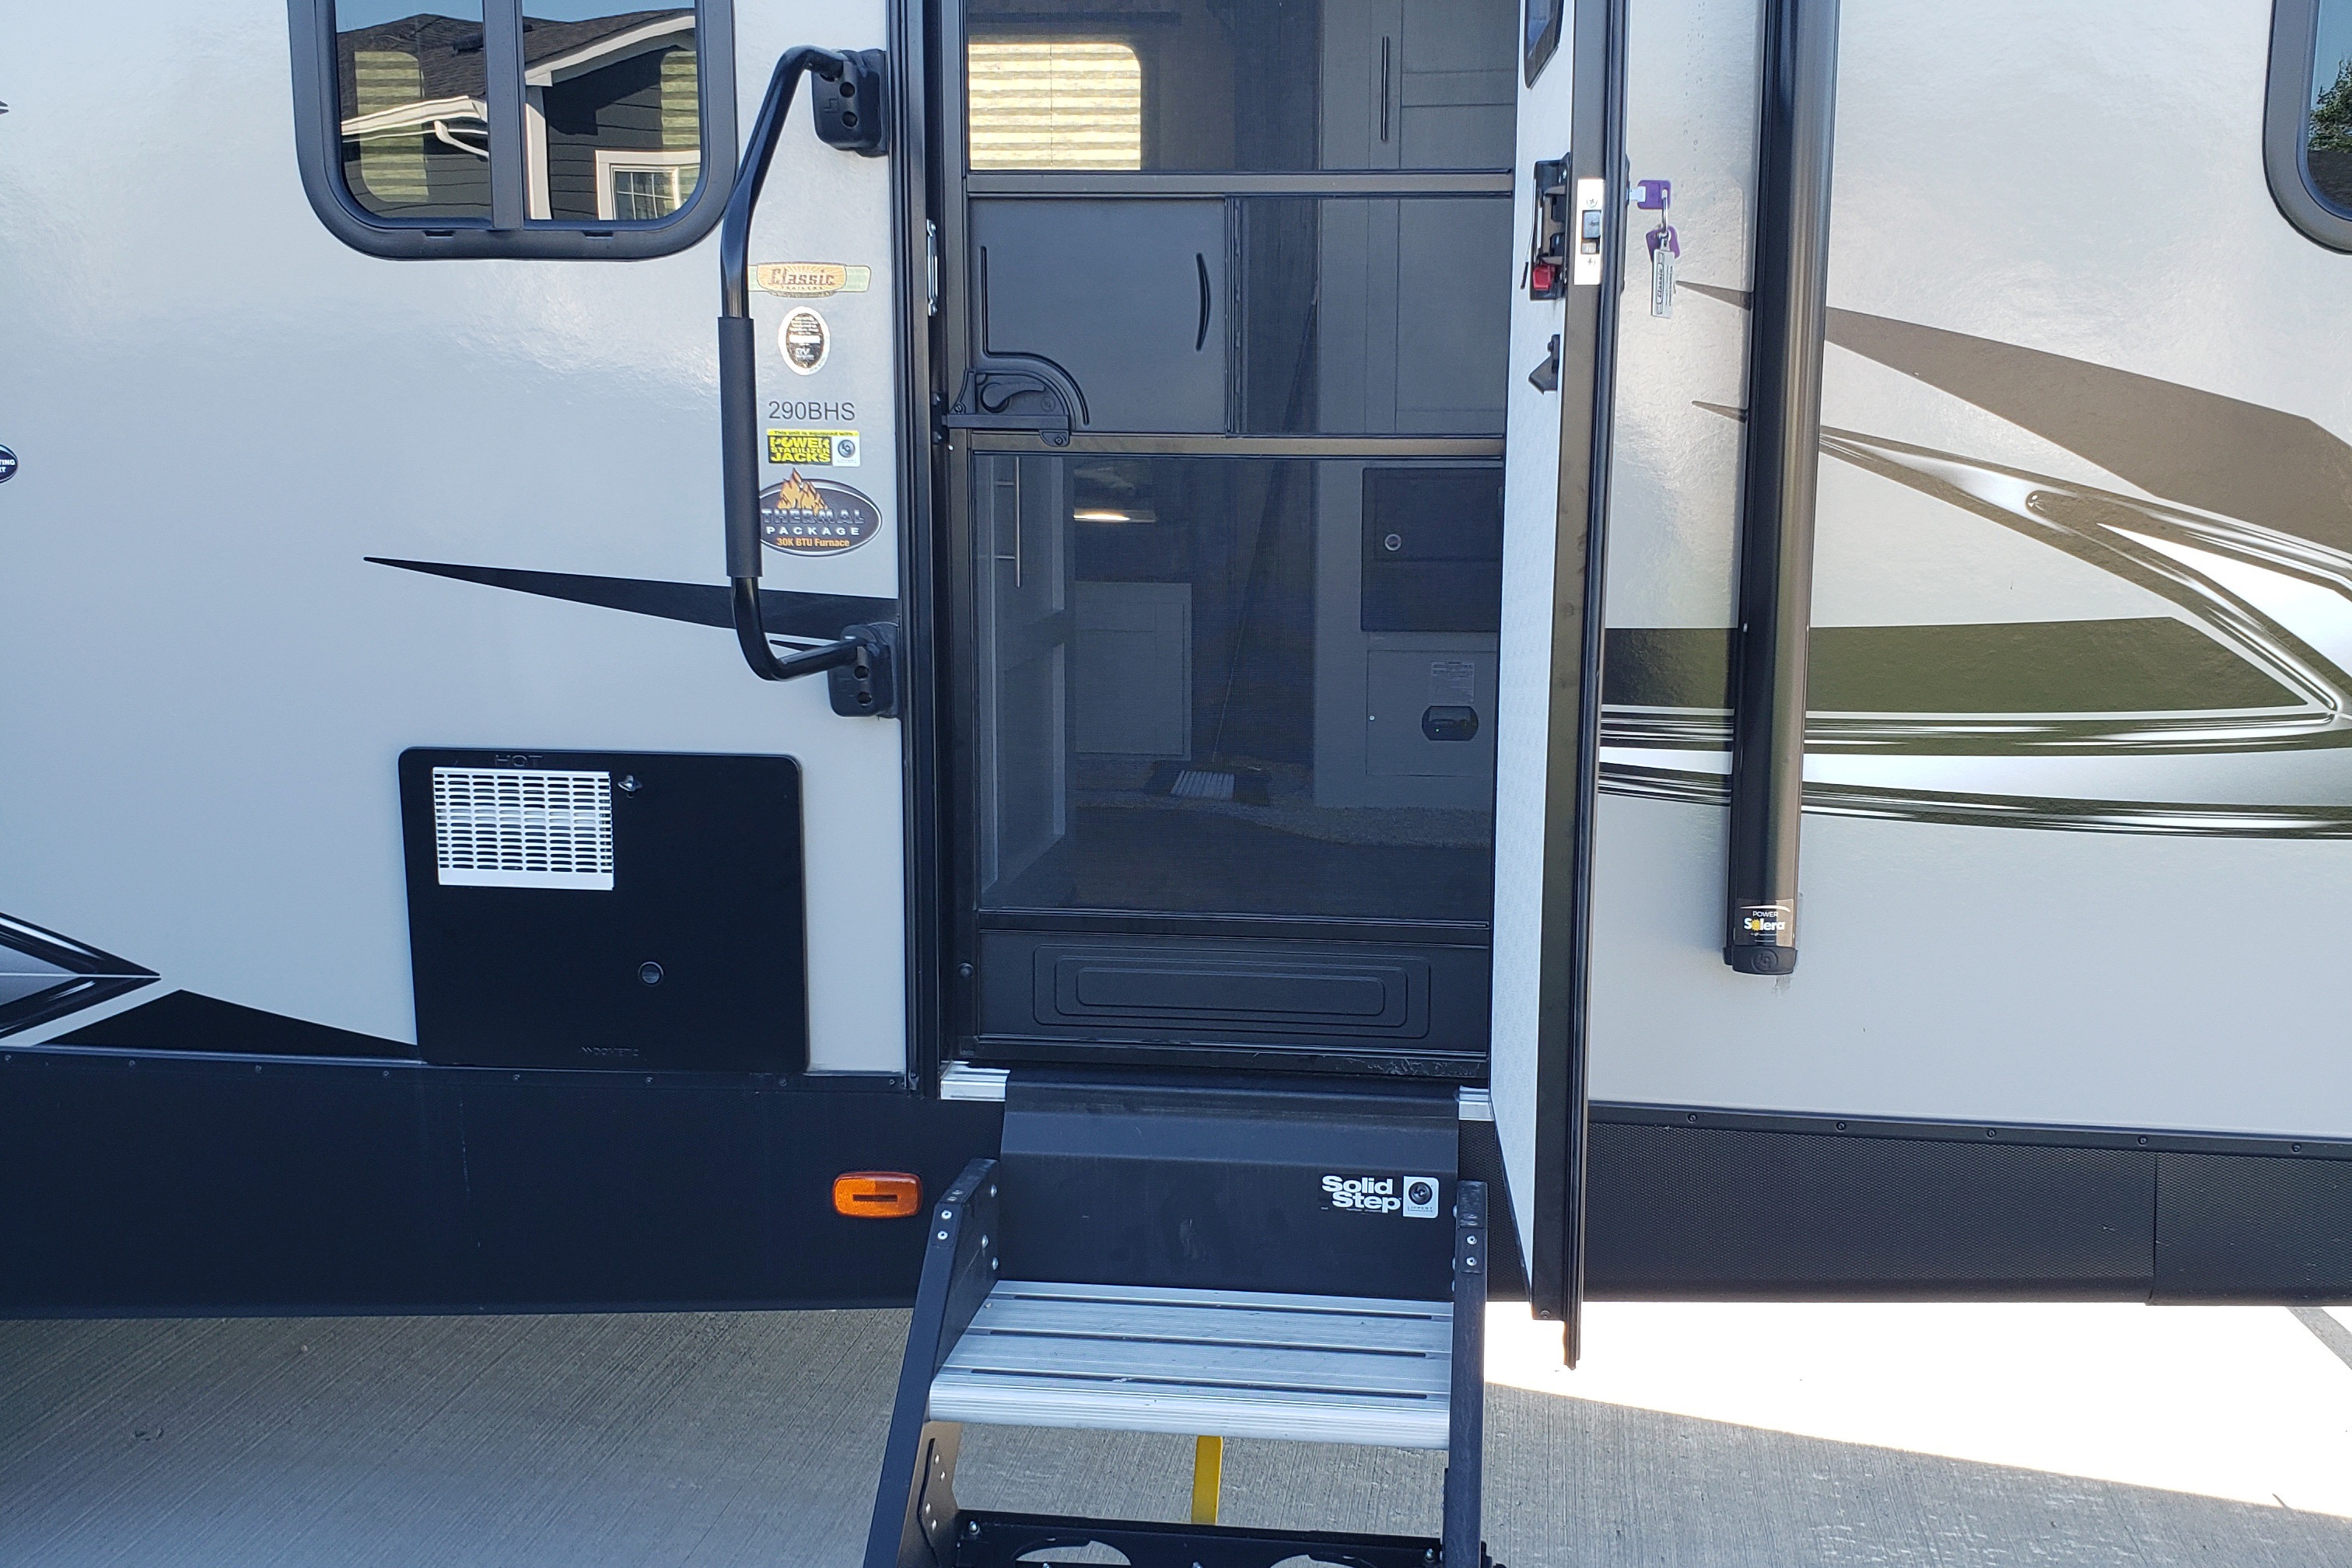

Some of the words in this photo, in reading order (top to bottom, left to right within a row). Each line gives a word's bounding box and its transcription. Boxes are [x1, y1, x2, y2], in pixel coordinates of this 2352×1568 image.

[768, 268, 835, 285] Classic
[768, 401, 856, 421] 290BHS
[770, 436, 830, 449] POWER
[770, 453, 831, 463] JACKS
[761, 508, 865, 525] THERMAL
[767, 527, 860, 536] PACKAGE
[777, 537, 794, 546] 30K
[796, 537, 813, 546] BTU
[815, 538, 850, 548] Furnace
[495, 754, 543, 768] HOT
[1744, 918, 1786, 931] Solera
[1321, 1175, 1394, 1195] Solid
[1332, 1191, 1401, 1214] Step
